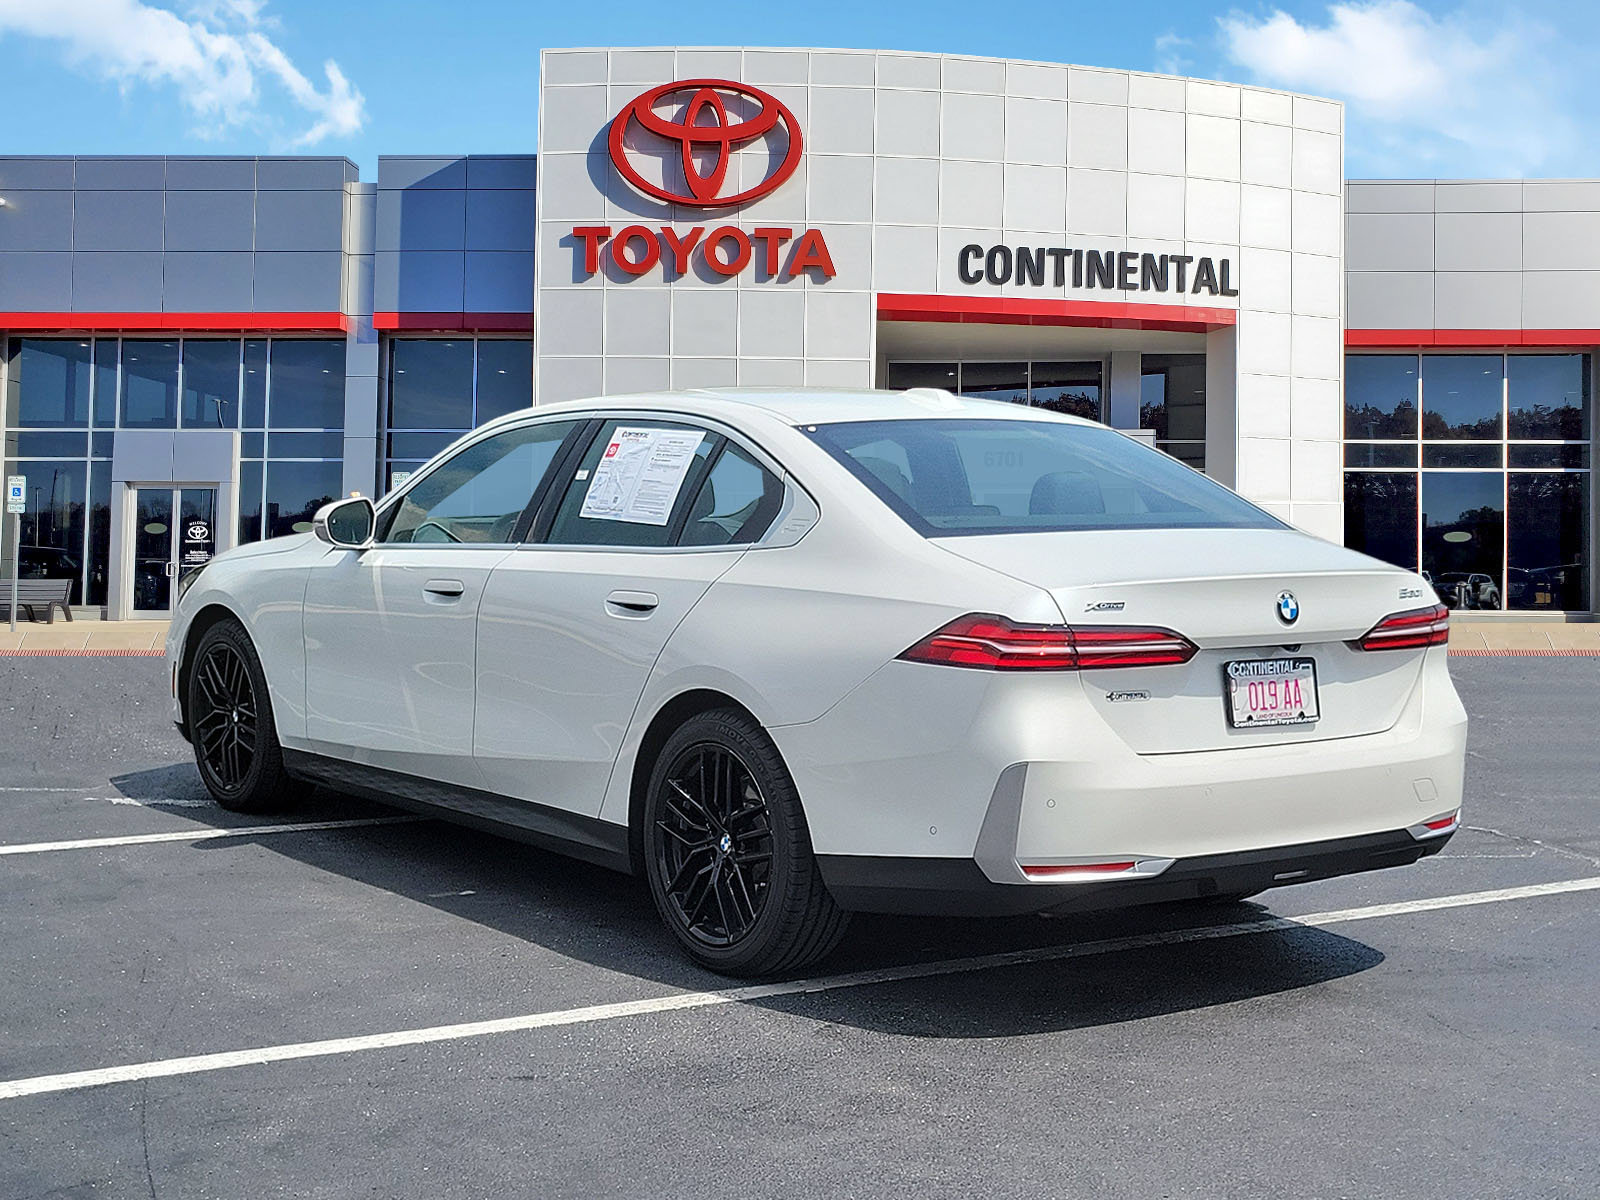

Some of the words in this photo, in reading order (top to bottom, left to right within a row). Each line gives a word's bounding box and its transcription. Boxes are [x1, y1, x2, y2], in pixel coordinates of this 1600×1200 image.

[572, 224, 837, 277] TOYOTA
[958, 243, 1239, 297] CONTINENTAL
[1230, 661, 1294, 676] CONTINENTAL
[1248, 681, 1278, 711] 019
[1284, 678, 1303, 709] AA
